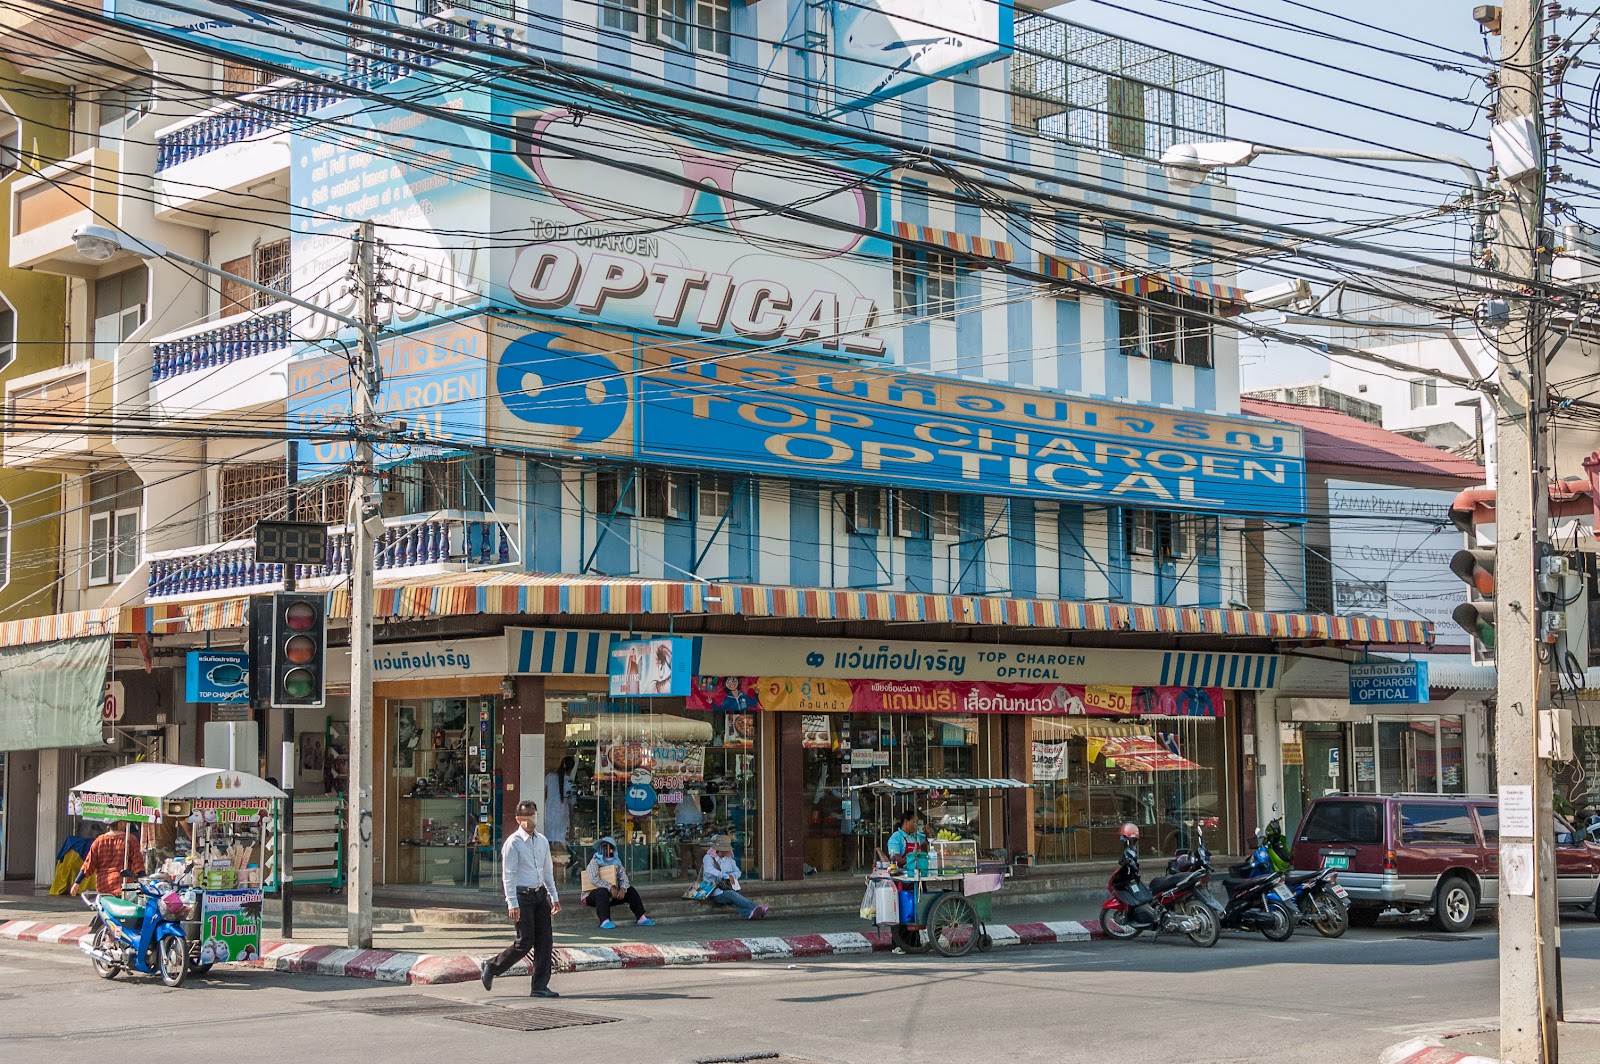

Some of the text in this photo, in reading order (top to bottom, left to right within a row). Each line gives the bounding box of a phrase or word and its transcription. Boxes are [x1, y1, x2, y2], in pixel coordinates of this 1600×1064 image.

[312, 185, 329, 206] Soft
[330, 175, 360, 199] contact
[362, 168, 388, 189] lenses
[530, 216, 659, 258] TOP CHAROEN
[508, 243, 886, 357] OPTICAL
[670, 391, 1285, 484] TOP CHAROEN
[764, 432, 1225, 506] OPTICAL
[1361, 544, 1423, 564] COMPLETE
[1393, 591, 1411, 599] House
[1411, 592, 1425, 600] start
[1393, 605, 1411, 613] House
[1424, 605, 1437, 616] pool
[1438, 606, 1448, 614] and
[374, 648, 471, 670] แว่นท็อปเจริญ
[834, 645, 966, 676] แว่นท็อปเจริญ
[977, 651, 1086, 666] TOP CHAROEN
[997, 666, 1060, 679] OPTICAL
[1351, 665, 1415, 676] แว่นท็อปเจริญ
[1351, 678, 1416, 688] TOP CHAROEN
[1358, 688, 1409, 700] OPTICAL
[881, 688, 957, 711] แถมฟรี!
[963, 687, 1053, 712] เสื้อกันหนาว
